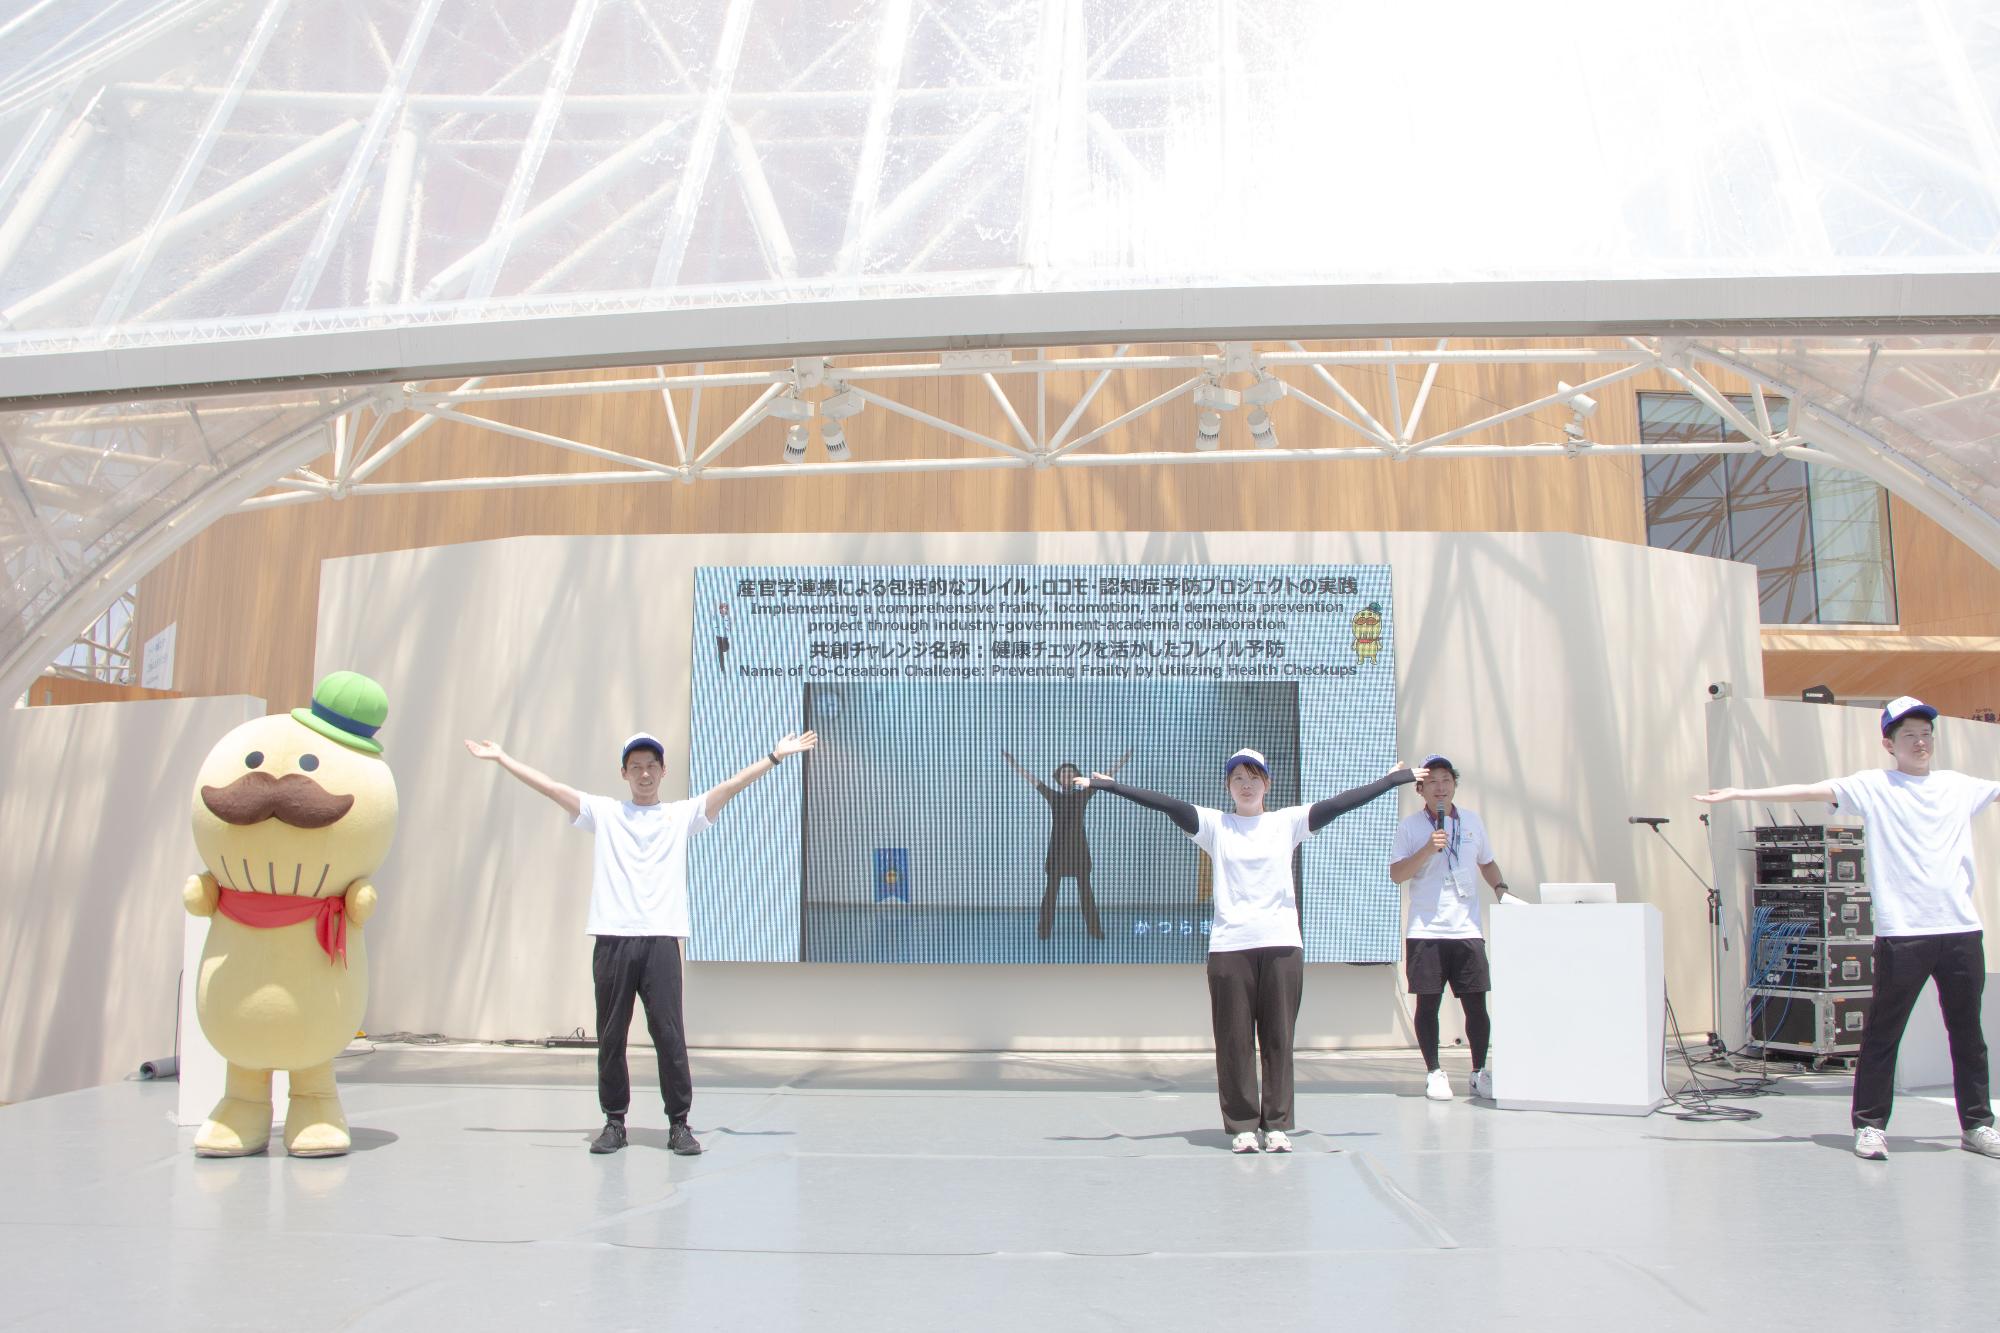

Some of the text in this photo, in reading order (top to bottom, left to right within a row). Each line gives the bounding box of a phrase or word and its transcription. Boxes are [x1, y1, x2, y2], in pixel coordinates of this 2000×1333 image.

[751, 601, 1344, 616] Implementing a comprehensive frailty, locomotion, and dementia prevention
[808, 618, 1286, 634] project through industry-government-academia collaboration
[739, 664, 1357, 680] Name of Co-Creation Challenge: Preventing Frailty by Utilizing Health Checkups
